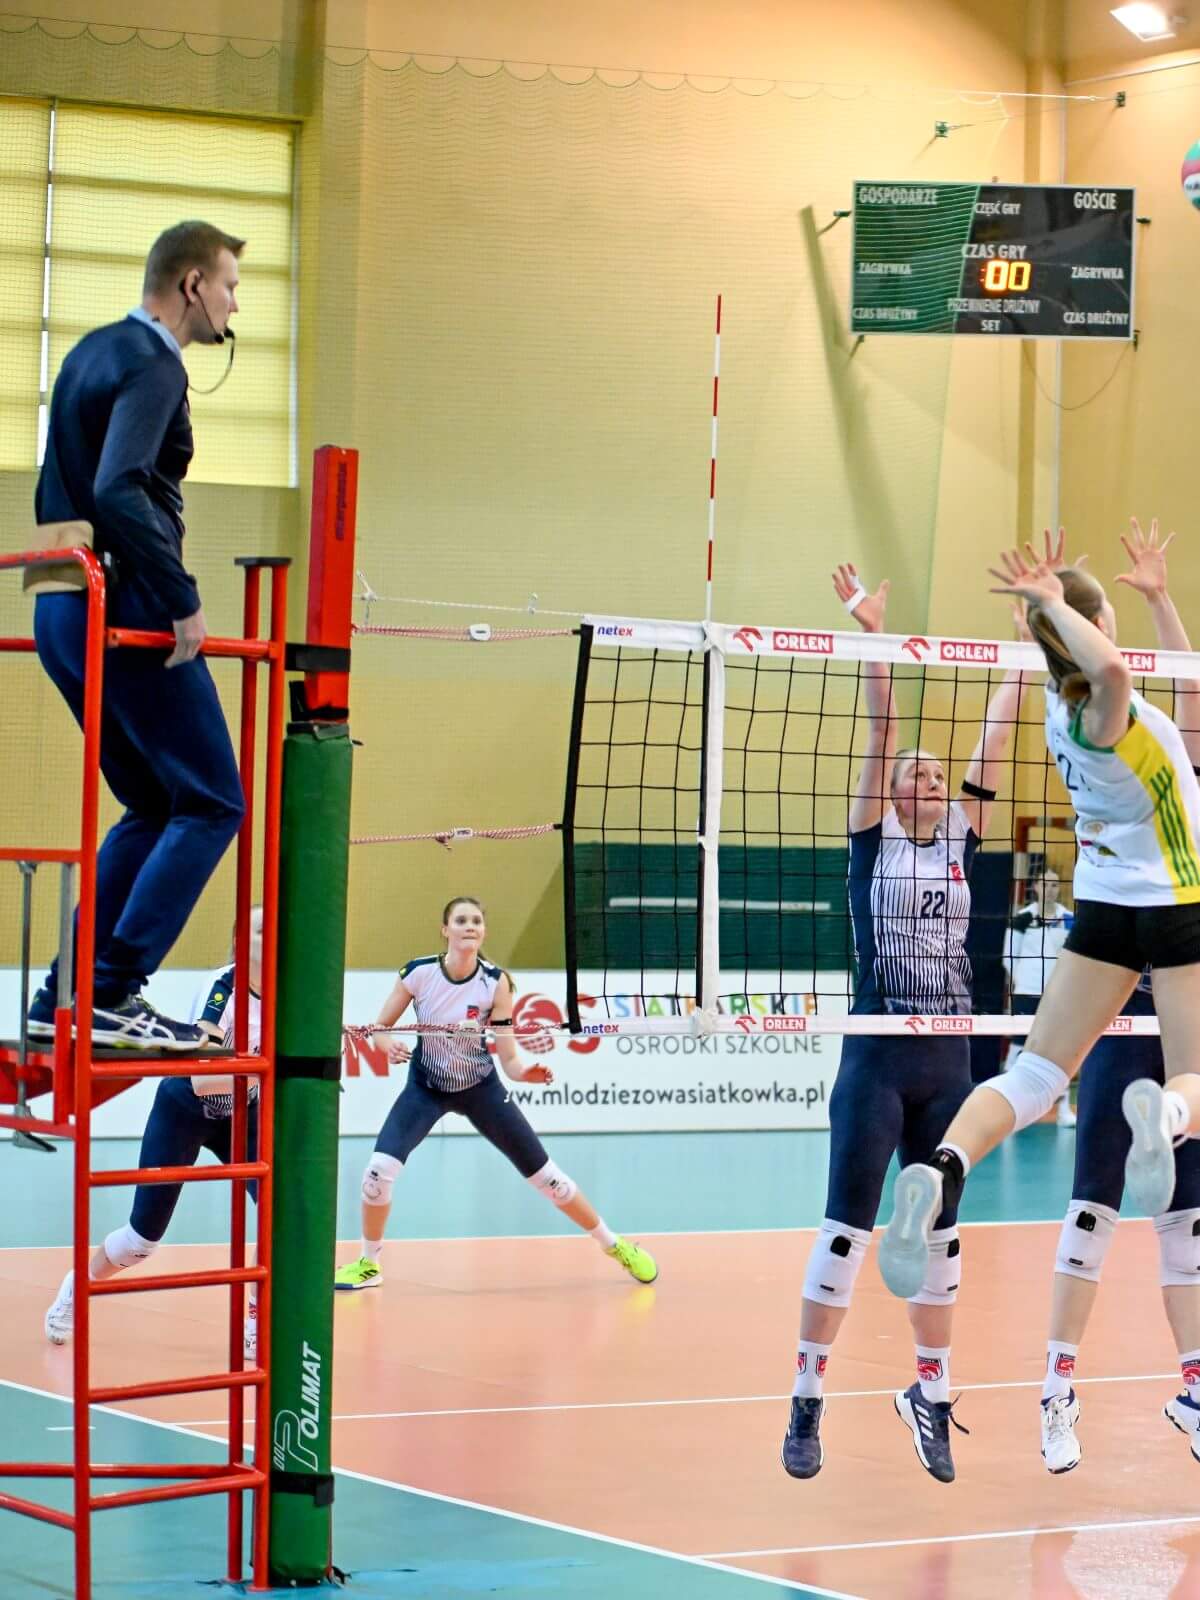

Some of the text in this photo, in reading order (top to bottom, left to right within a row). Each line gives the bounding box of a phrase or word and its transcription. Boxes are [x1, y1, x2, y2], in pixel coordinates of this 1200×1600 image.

[859, 186, 938, 205] GOSPODARZE
[1073, 188, 1117, 210] GOŚCIE
[1002, 203, 1021, 215] GRY
[962, 244, 1027, 259] CZAS GRY
[1071, 266, 1124, 279] ZAGRYWKA
[1063, 310, 1129, 325] CZAS DRUŻYNY
[981, 319, 1001, 332] SET
[597, 625, 633, 637] netex
[775, 633, 829, 651] ORLEN
[942, 643, 995, 661] ORLEN
[920, 890, 946, 918] 22
[583, 1023, 619, 1034] netex
[765, 1019, 804, 1030] ORLEN
[933, 1019, 971, 1031] ORLEN
[726, 1035, 822, 1054] SZKOLNE
